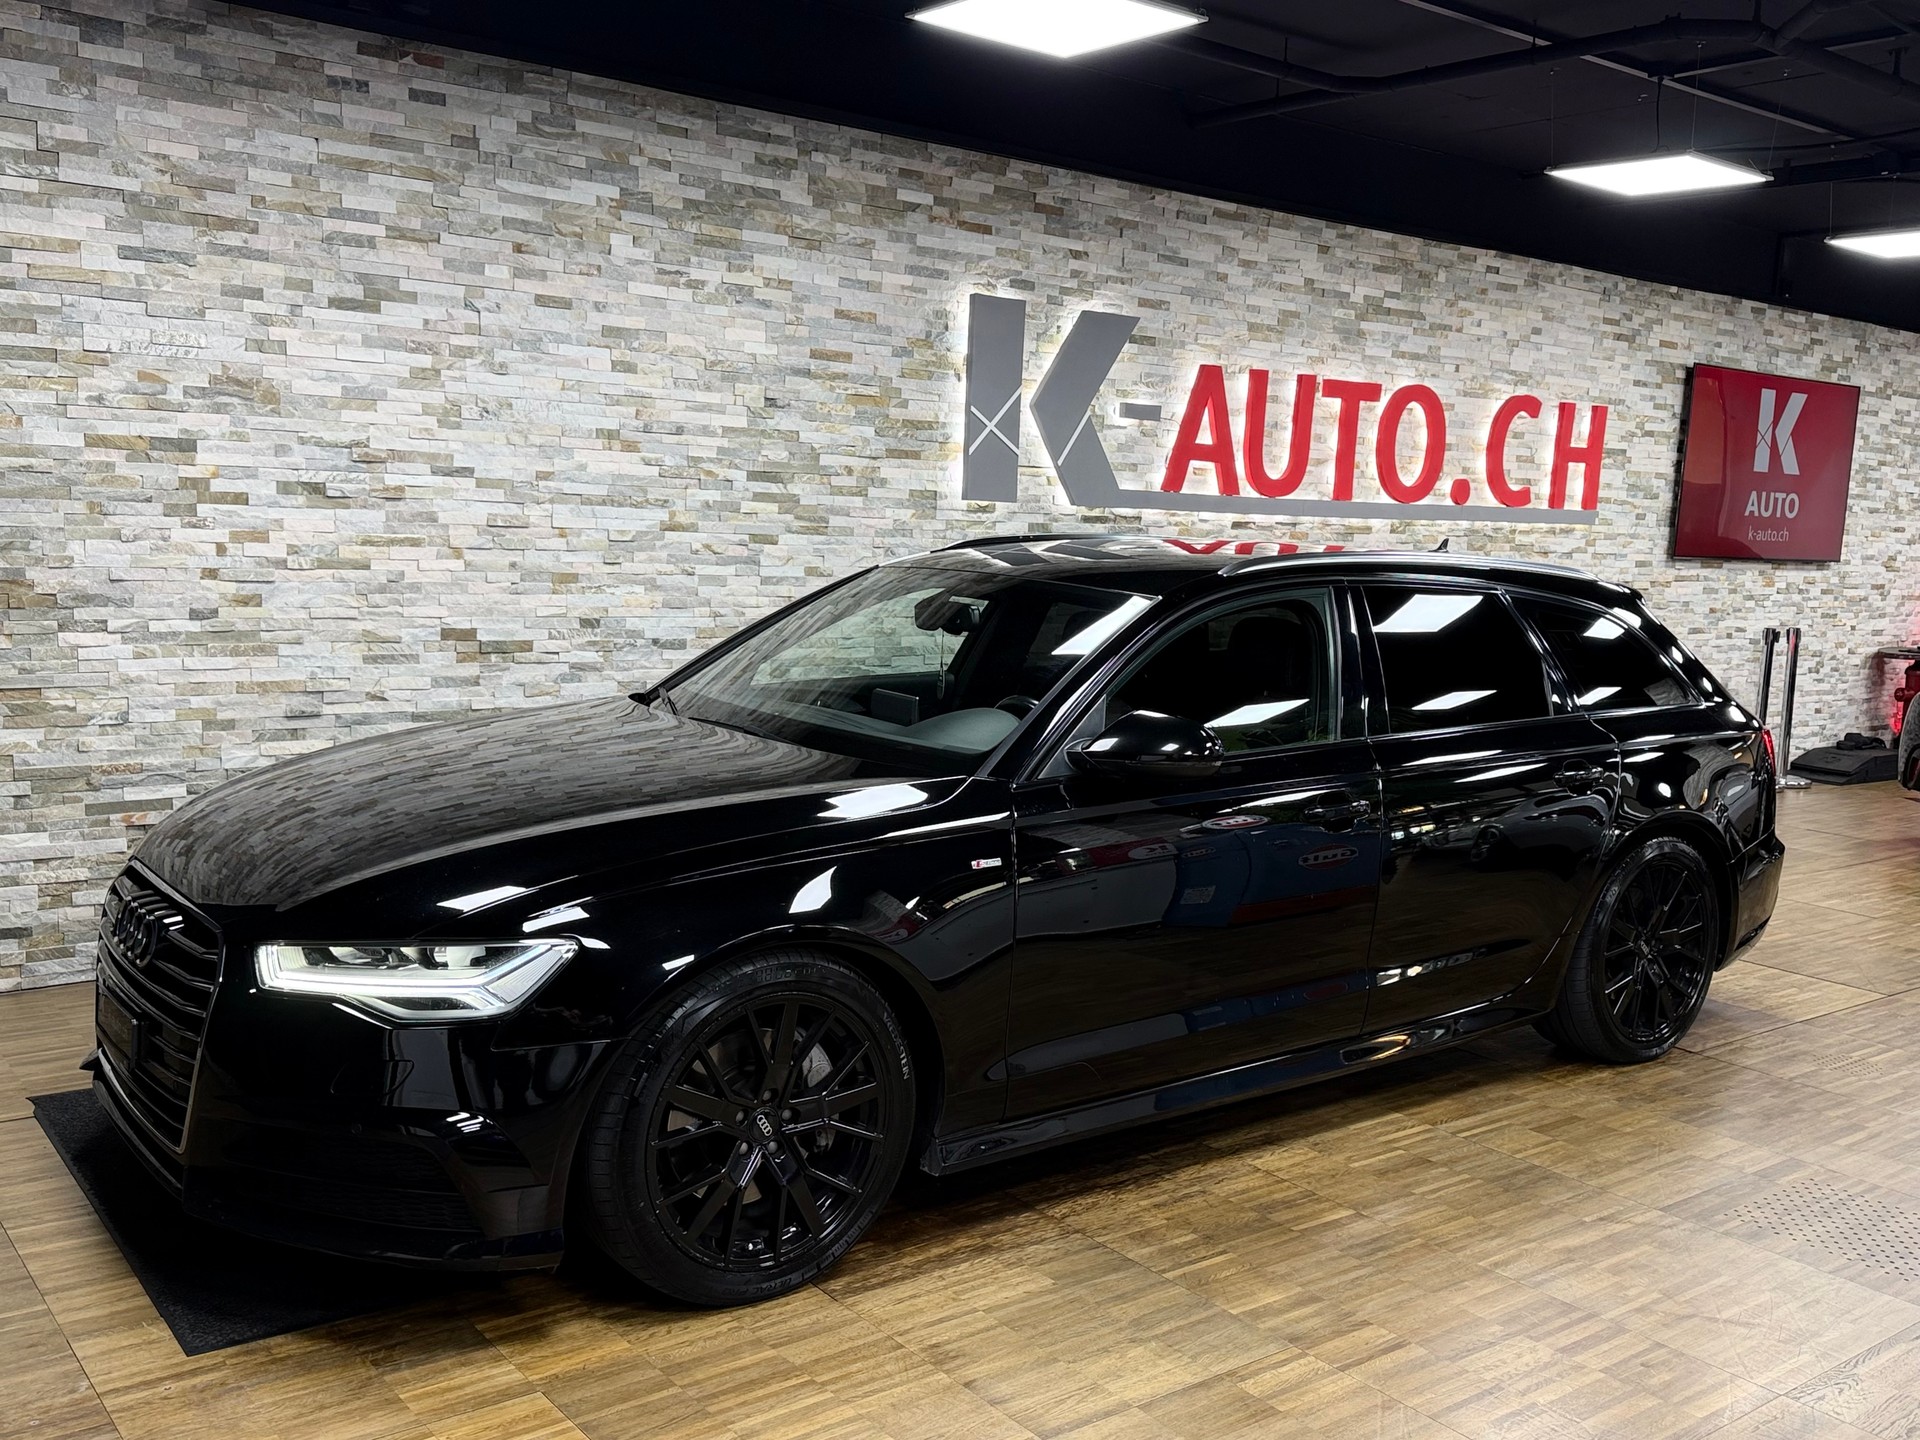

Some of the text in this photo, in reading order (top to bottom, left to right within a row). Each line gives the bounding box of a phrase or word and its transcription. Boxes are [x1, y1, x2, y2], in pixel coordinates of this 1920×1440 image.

[962, 293, 1608, 512] K-AUTO.CH
[1753, 388, 1808, 475] K
[1744, 490, 1800, 519] AUTO
[1748, 525, 1789, 542] k-auto.ch
